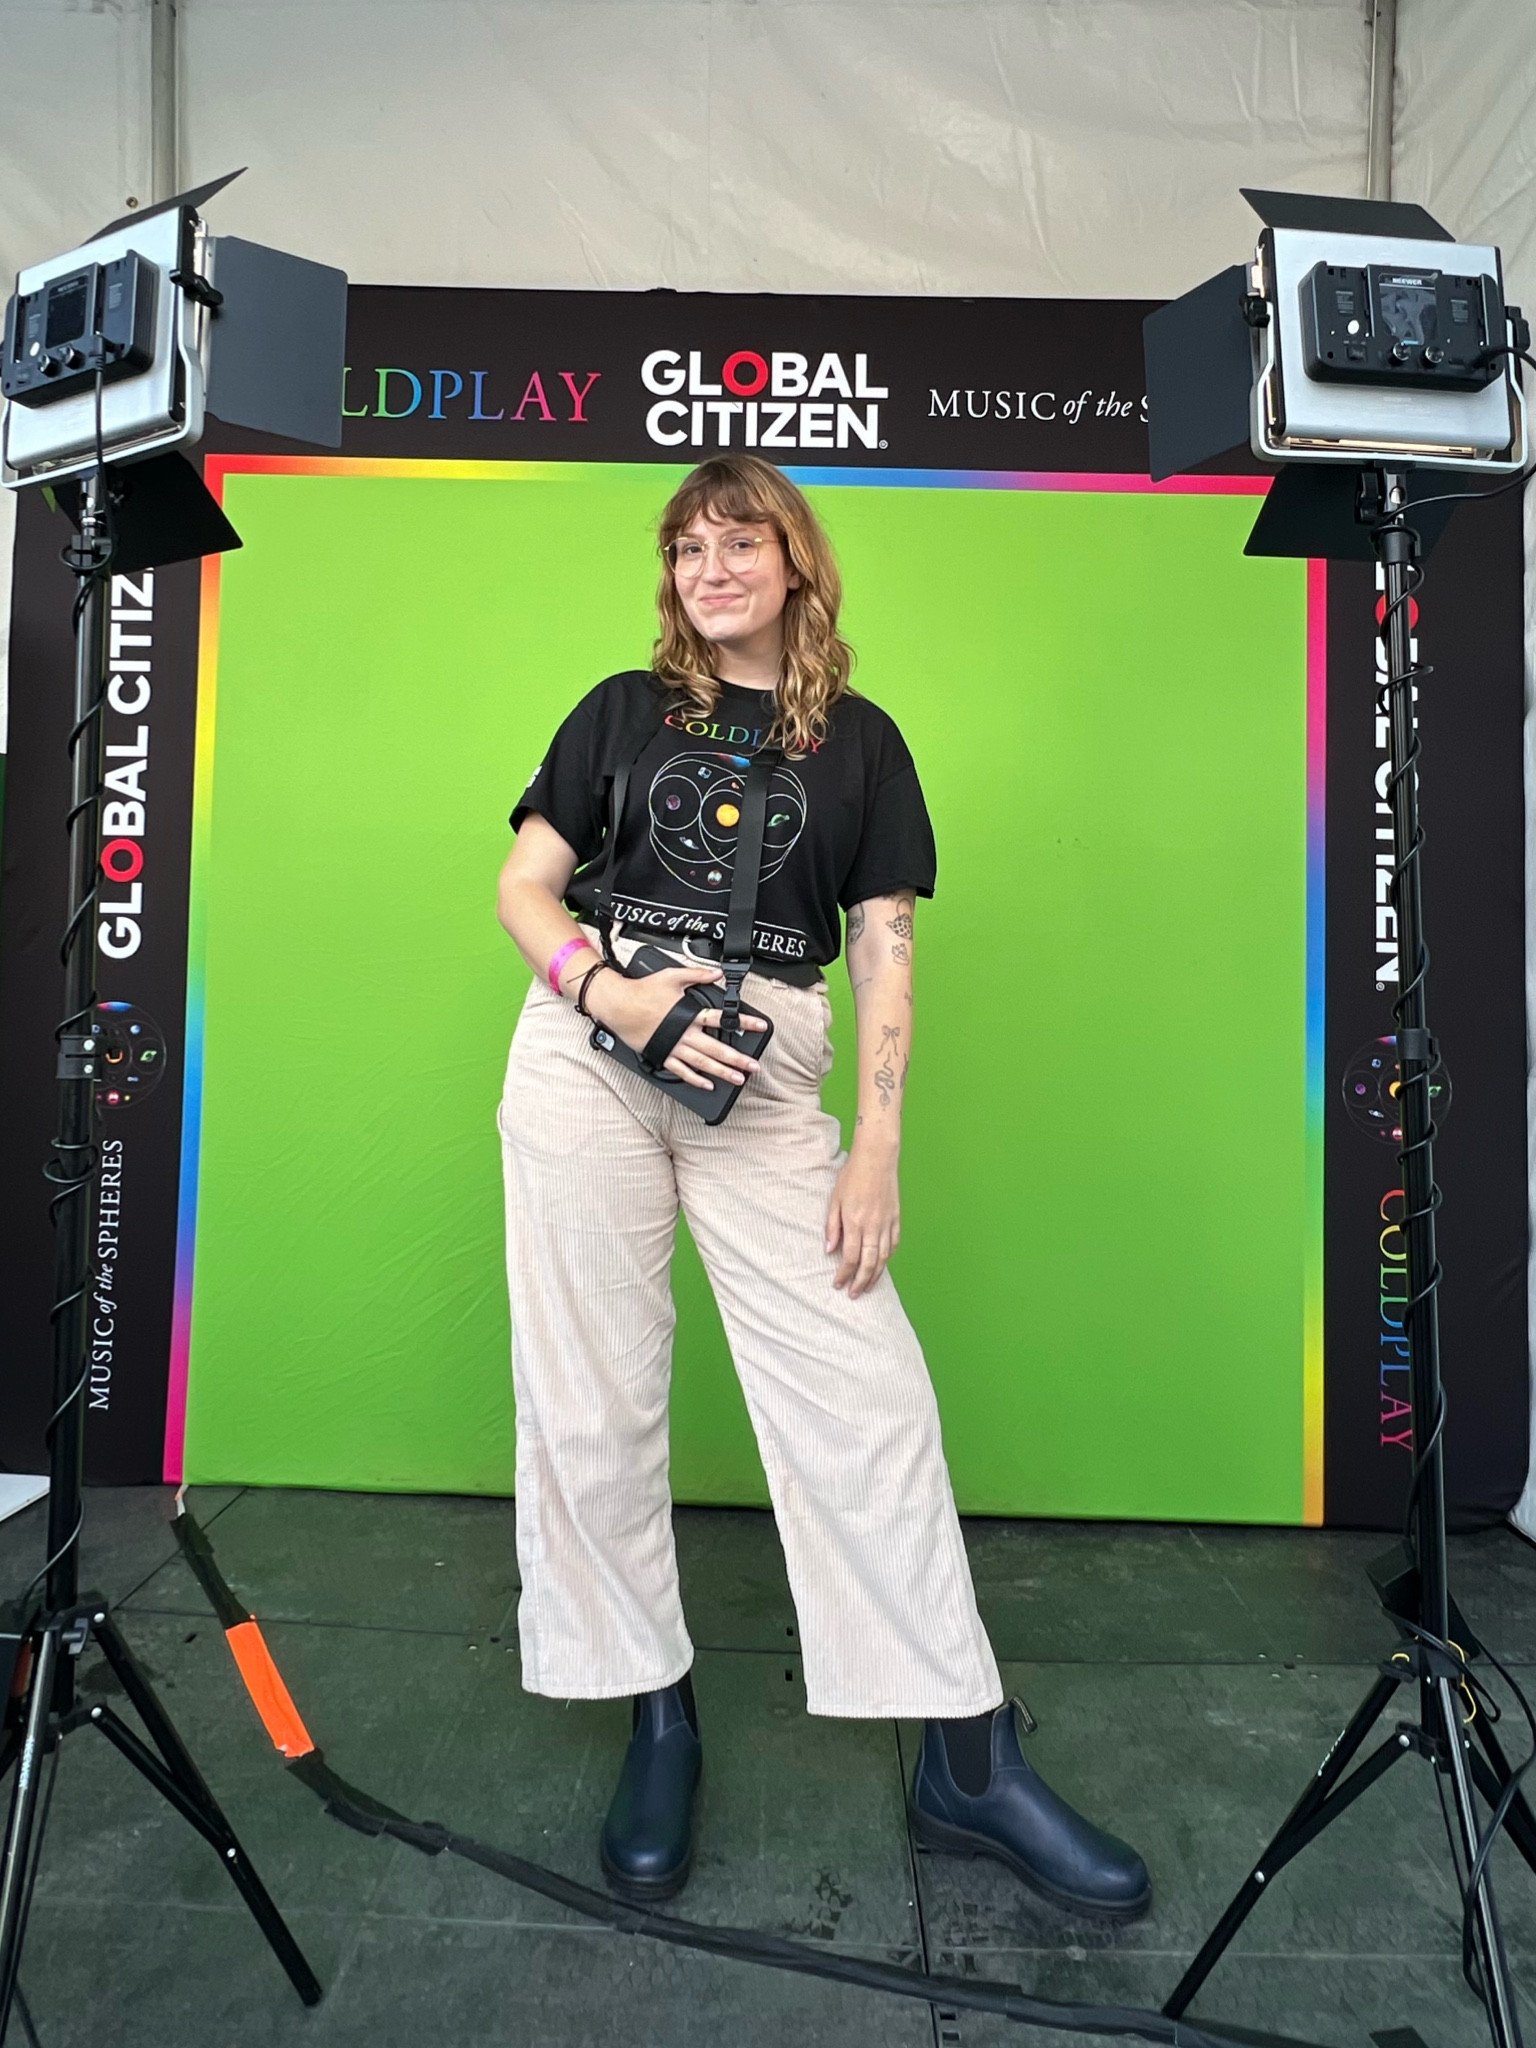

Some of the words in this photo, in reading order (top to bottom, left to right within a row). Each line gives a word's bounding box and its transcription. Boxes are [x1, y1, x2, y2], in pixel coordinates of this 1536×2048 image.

[341, 367, 602, 422] LDPLAY
[641, 350, 889, 398] GLOBAL
[645, 400, 879, 449] CITIZEN
[927, 388, 1057, 421] MUSIC
[1062, 391, 1092, 425] of
[1096, 390, 1134, 418] the
[107, 567, 154, 715] CITIZ
[98, 725, 149, 959] GLOBAL
[611, 901, 666, 927] USIC
[667, 913, 689, 931] of
[684, 915, 710, 934] the
[712, 920, 807, 958] SERES
[97, 1140, 123, 1259] SPHERES
[94, 1292, 118, 1314] of
[95, 1264, 114, 1290] the
[88, 1318, 114, 1410] MUSIC
